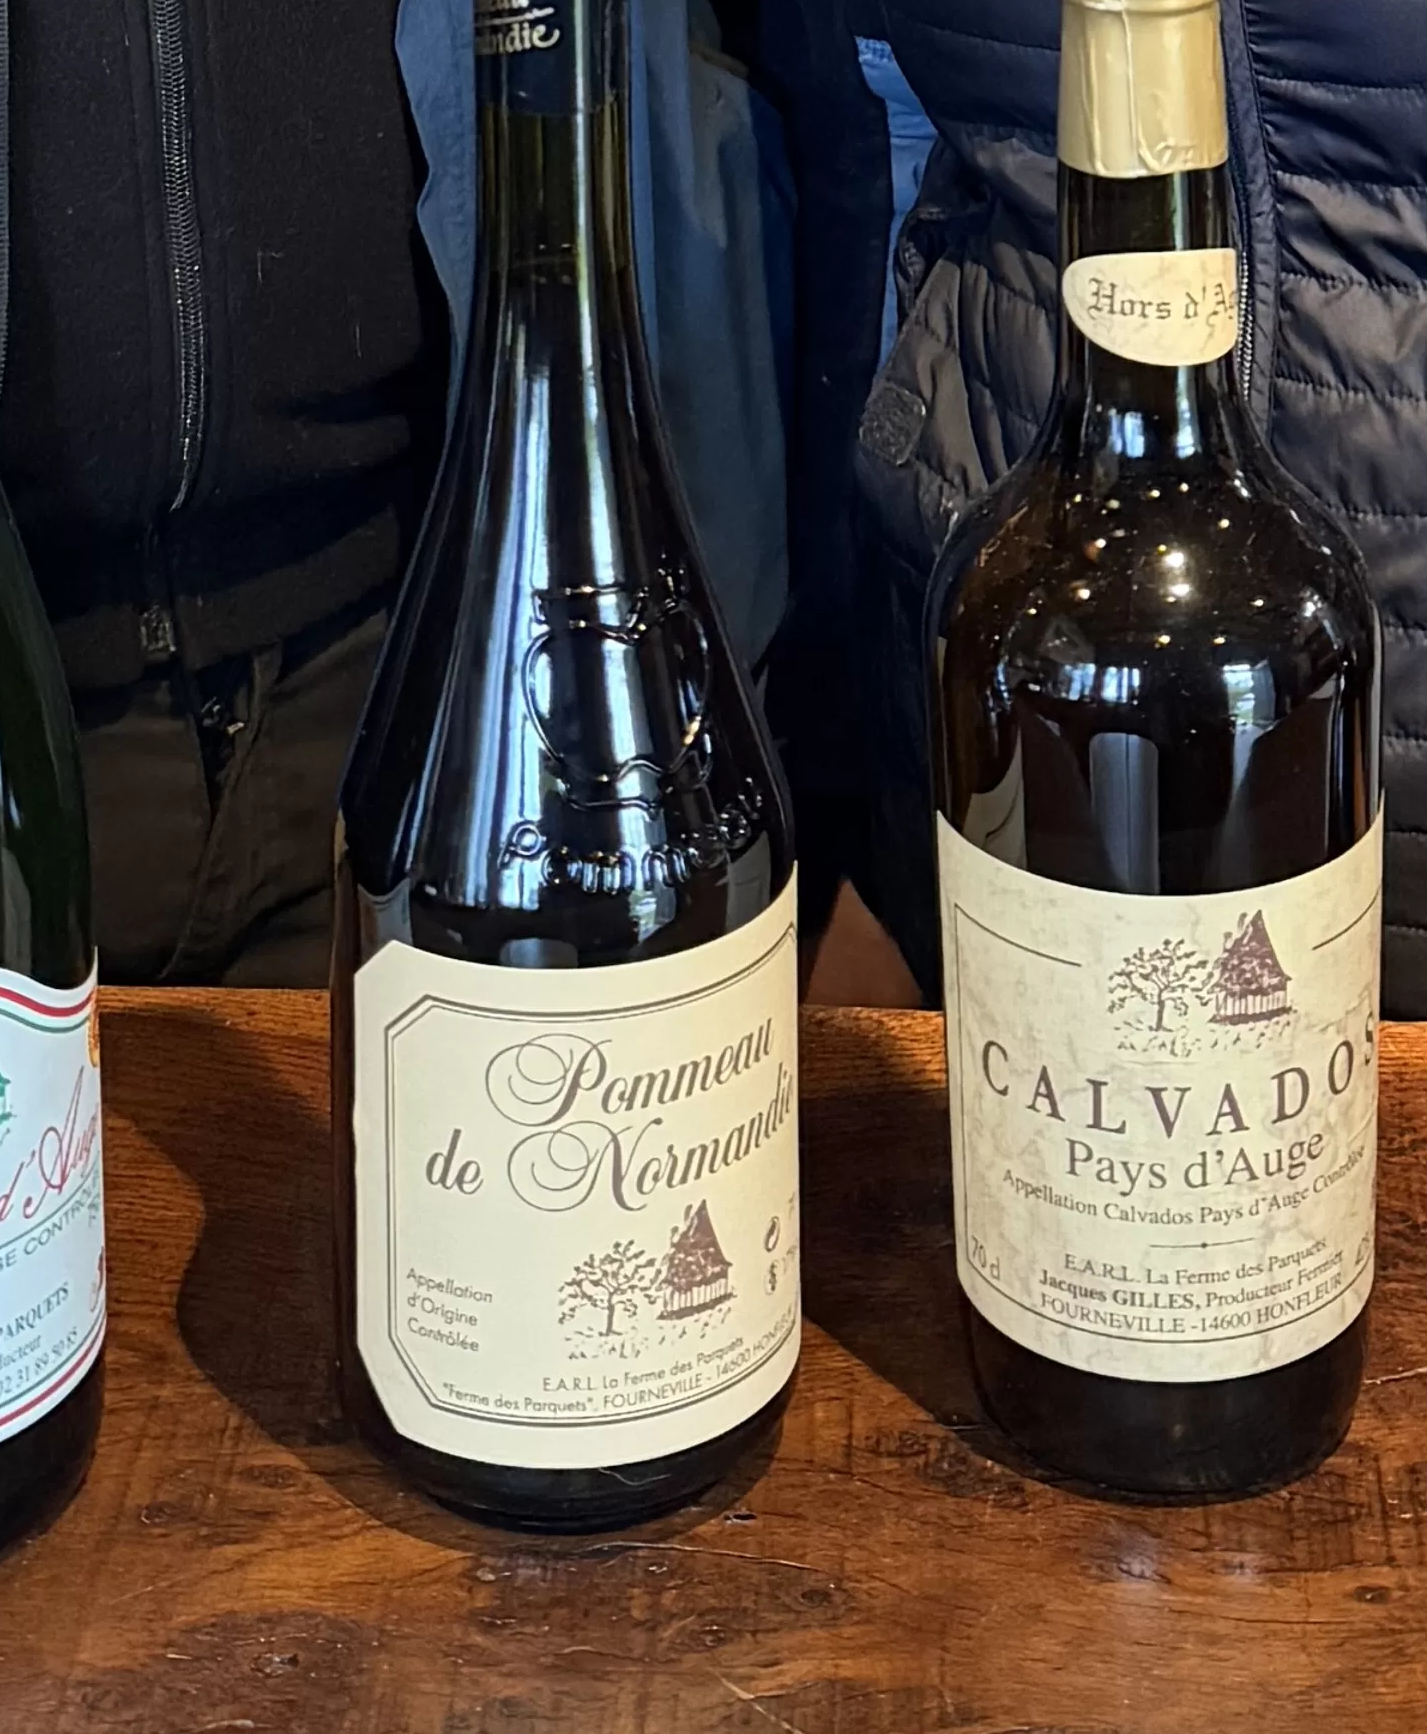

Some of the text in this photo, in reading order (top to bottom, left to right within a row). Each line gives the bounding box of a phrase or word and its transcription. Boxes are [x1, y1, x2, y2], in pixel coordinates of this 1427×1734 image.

[1087, 276, 1172, 321] Hors
[484, 1017, 775, 1128] Pommeau
[424, 1127, 485, 1196] de
[1064, 1132, 1325, 1197] Pays d'Auge
[1001, 1168, 1099, 1217] Appellation
[1103, 1202, 1194, 1226] Calvados
[1199, 1205, 1244, 1227] Pays
[1248, 1186, 1310, 1217] d'Auge
[405, 1267, 494, 1304] Appellation
[1038, 1268, 1108, 1304] Jacques
[1111, 1288, 1202, 1312] GILLES,
[1205, 1276, 1294, 1309] Producteur
[1296, 1248, 1344, 1286] Fermier
[1146, 1267, 1170, 1285] La
[1174, 1268, 1231, 1286] Ferme
[1235, 1262, 1264, 1280] des
[1267, 1236, 1329, 1273] Parquets
[406, 1291, 479, 1327] d'Origine
[1040, 1291, 1187, 1334] FOURNEVILLE
[1256, 1272, 1342, 1325] HONFLEUR
[406, 1316, 480, 1352] Contrôlée
[623, 1367, 666, 1387] Ferme
[669, 1360, 693, 1377] des
[696, 1335, 745, 1367] Parquets
[493, 1394, 520, 1411] des
[602, 1372, 704, 1408] FOURNEVILLE
[715, 1347, 752, 1380] 14600
